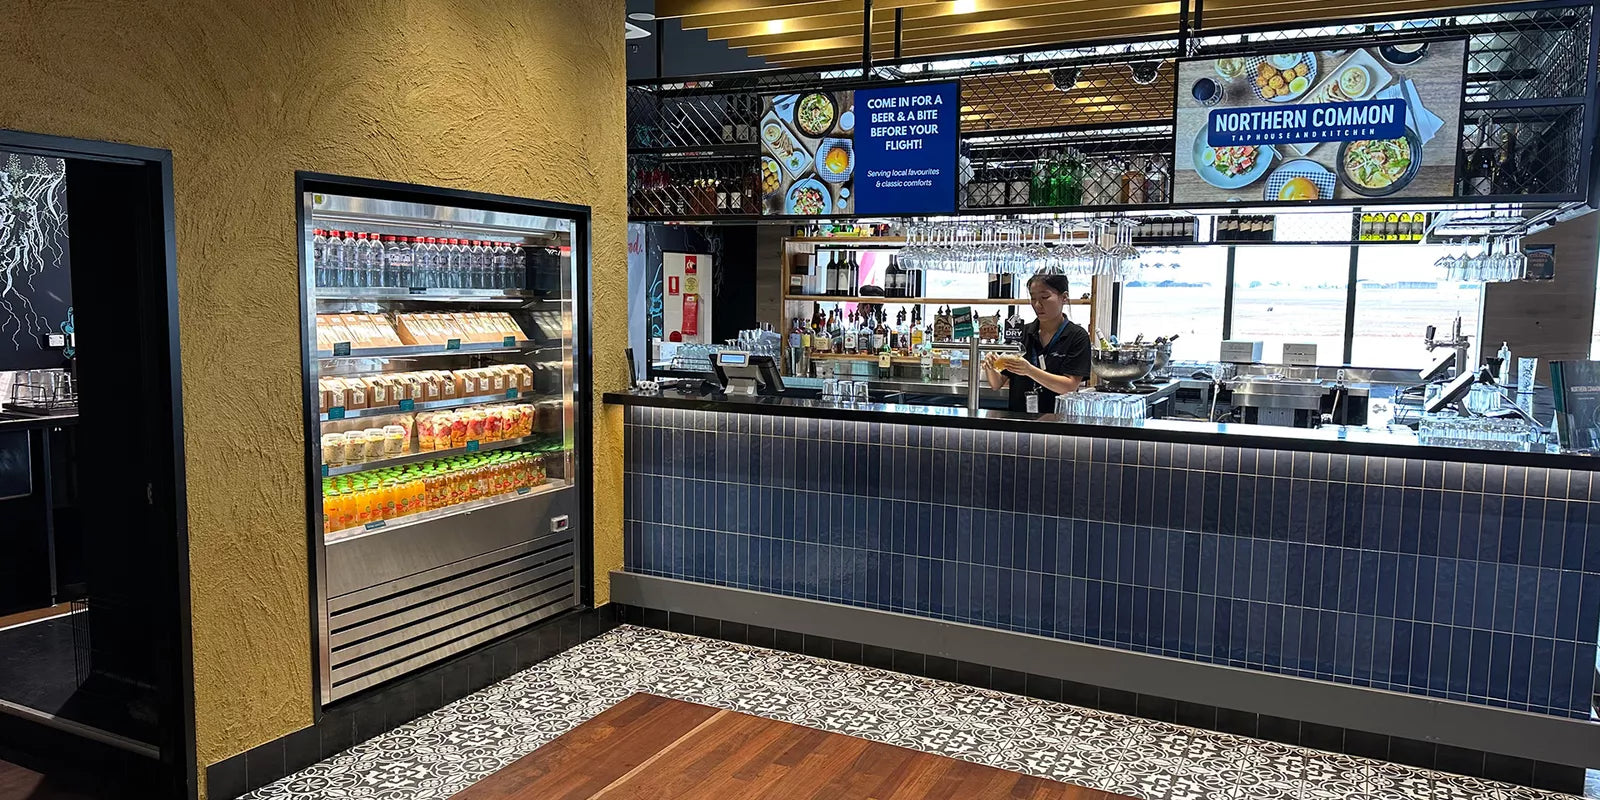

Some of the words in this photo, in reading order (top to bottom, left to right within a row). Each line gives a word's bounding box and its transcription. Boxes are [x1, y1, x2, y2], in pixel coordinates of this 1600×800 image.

[867, 97, 897, 109] COME
[898, 96, 909, 107] IN
[912, 95, 933, 106] FOR
[934, 94, 943, 105] A
[871, 112, 895, 123] BEER
[897, 111, 906, 122] &
[907, 111, 915, 121] A
[917, 109, 938, 120] BITE
[1215, 109, 1307, 132] NORTHERN
[1312, 104, 1394, 127] COMMON
[870, 125, 907, 137] BEFORE
[909, 124, 939, 135] YOUR
[1321, 128, 1375, 137] KITCHEN
[885, 139, 922, 151] FLIGHT!
[867, 170, 891, 178] Serving
[908, 168, 940, 176] favourites
[875, 180, 881, 188] &
[903, 178, 932, 187] comforts
